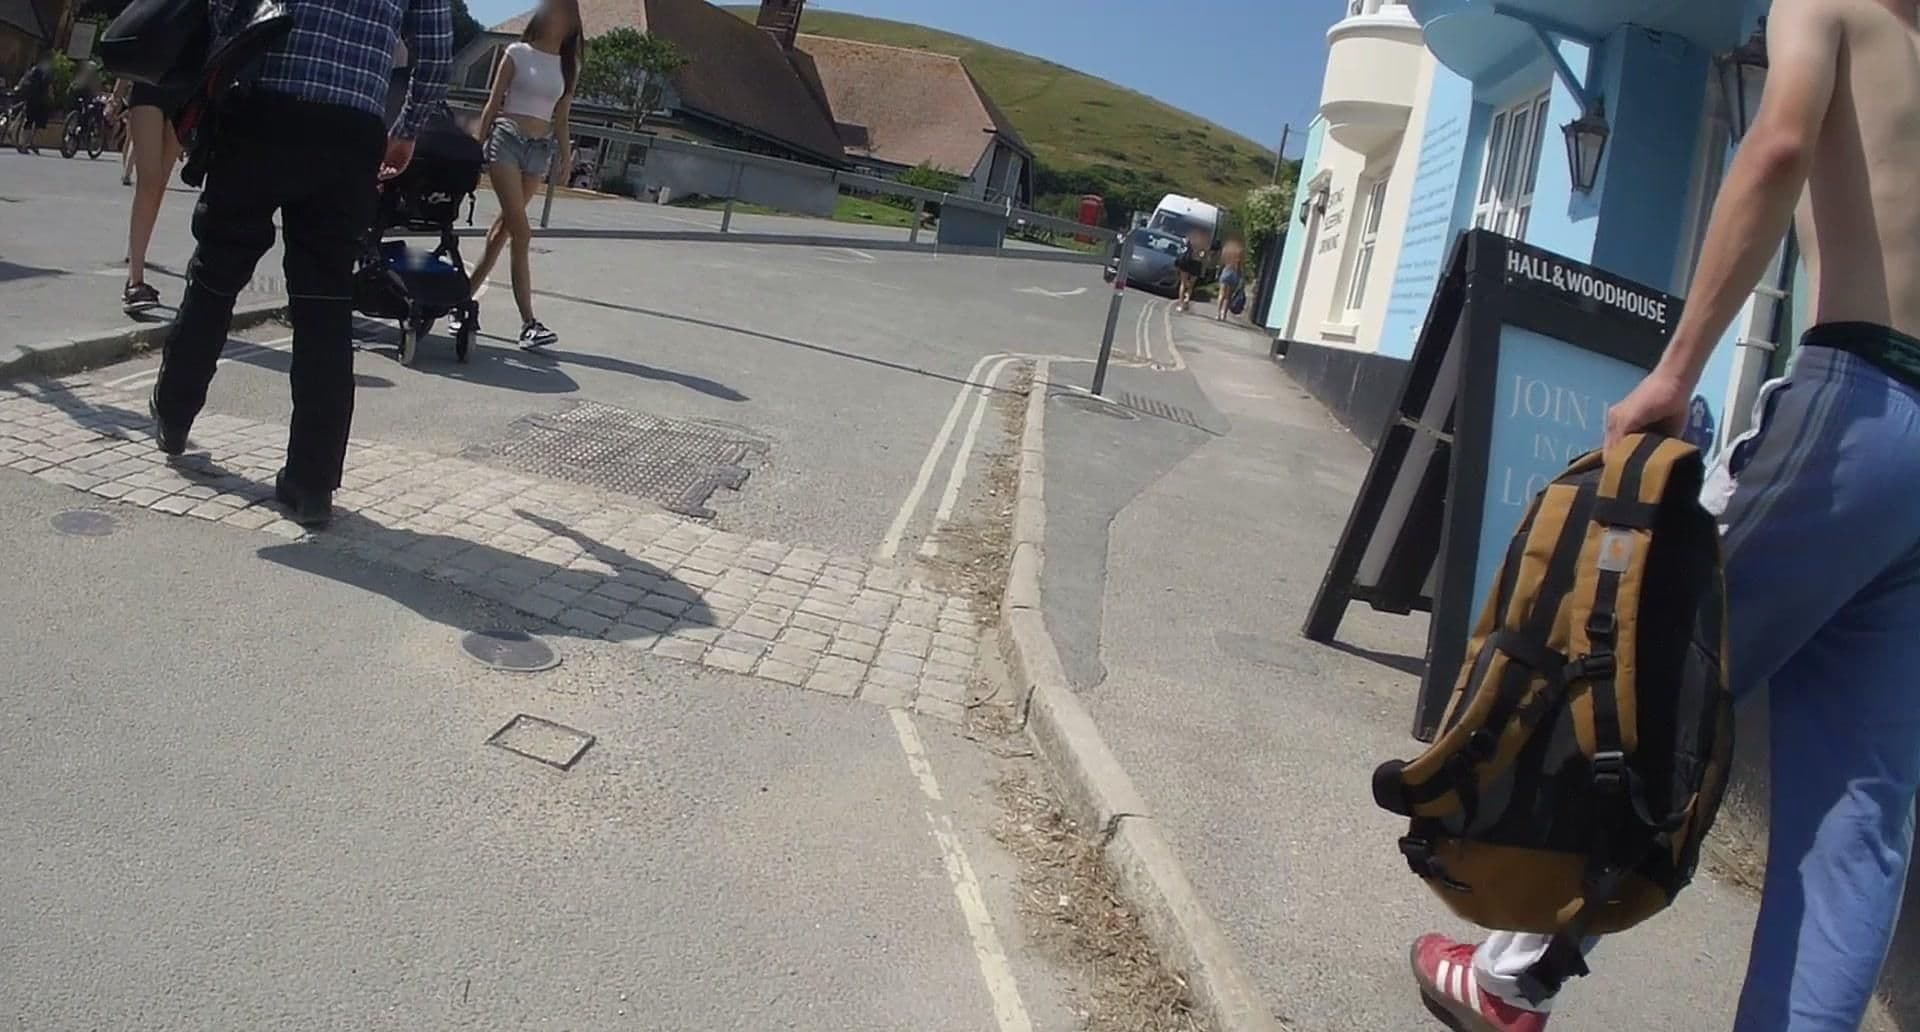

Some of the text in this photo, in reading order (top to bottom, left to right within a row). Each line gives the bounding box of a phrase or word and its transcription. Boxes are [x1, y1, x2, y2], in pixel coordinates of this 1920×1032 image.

[1507, 250, 1667, 323] HALL&WOODHOUSE
[1510, 376, 1591, 429] JOIN
[1533, 434, 1558, 461] IN
